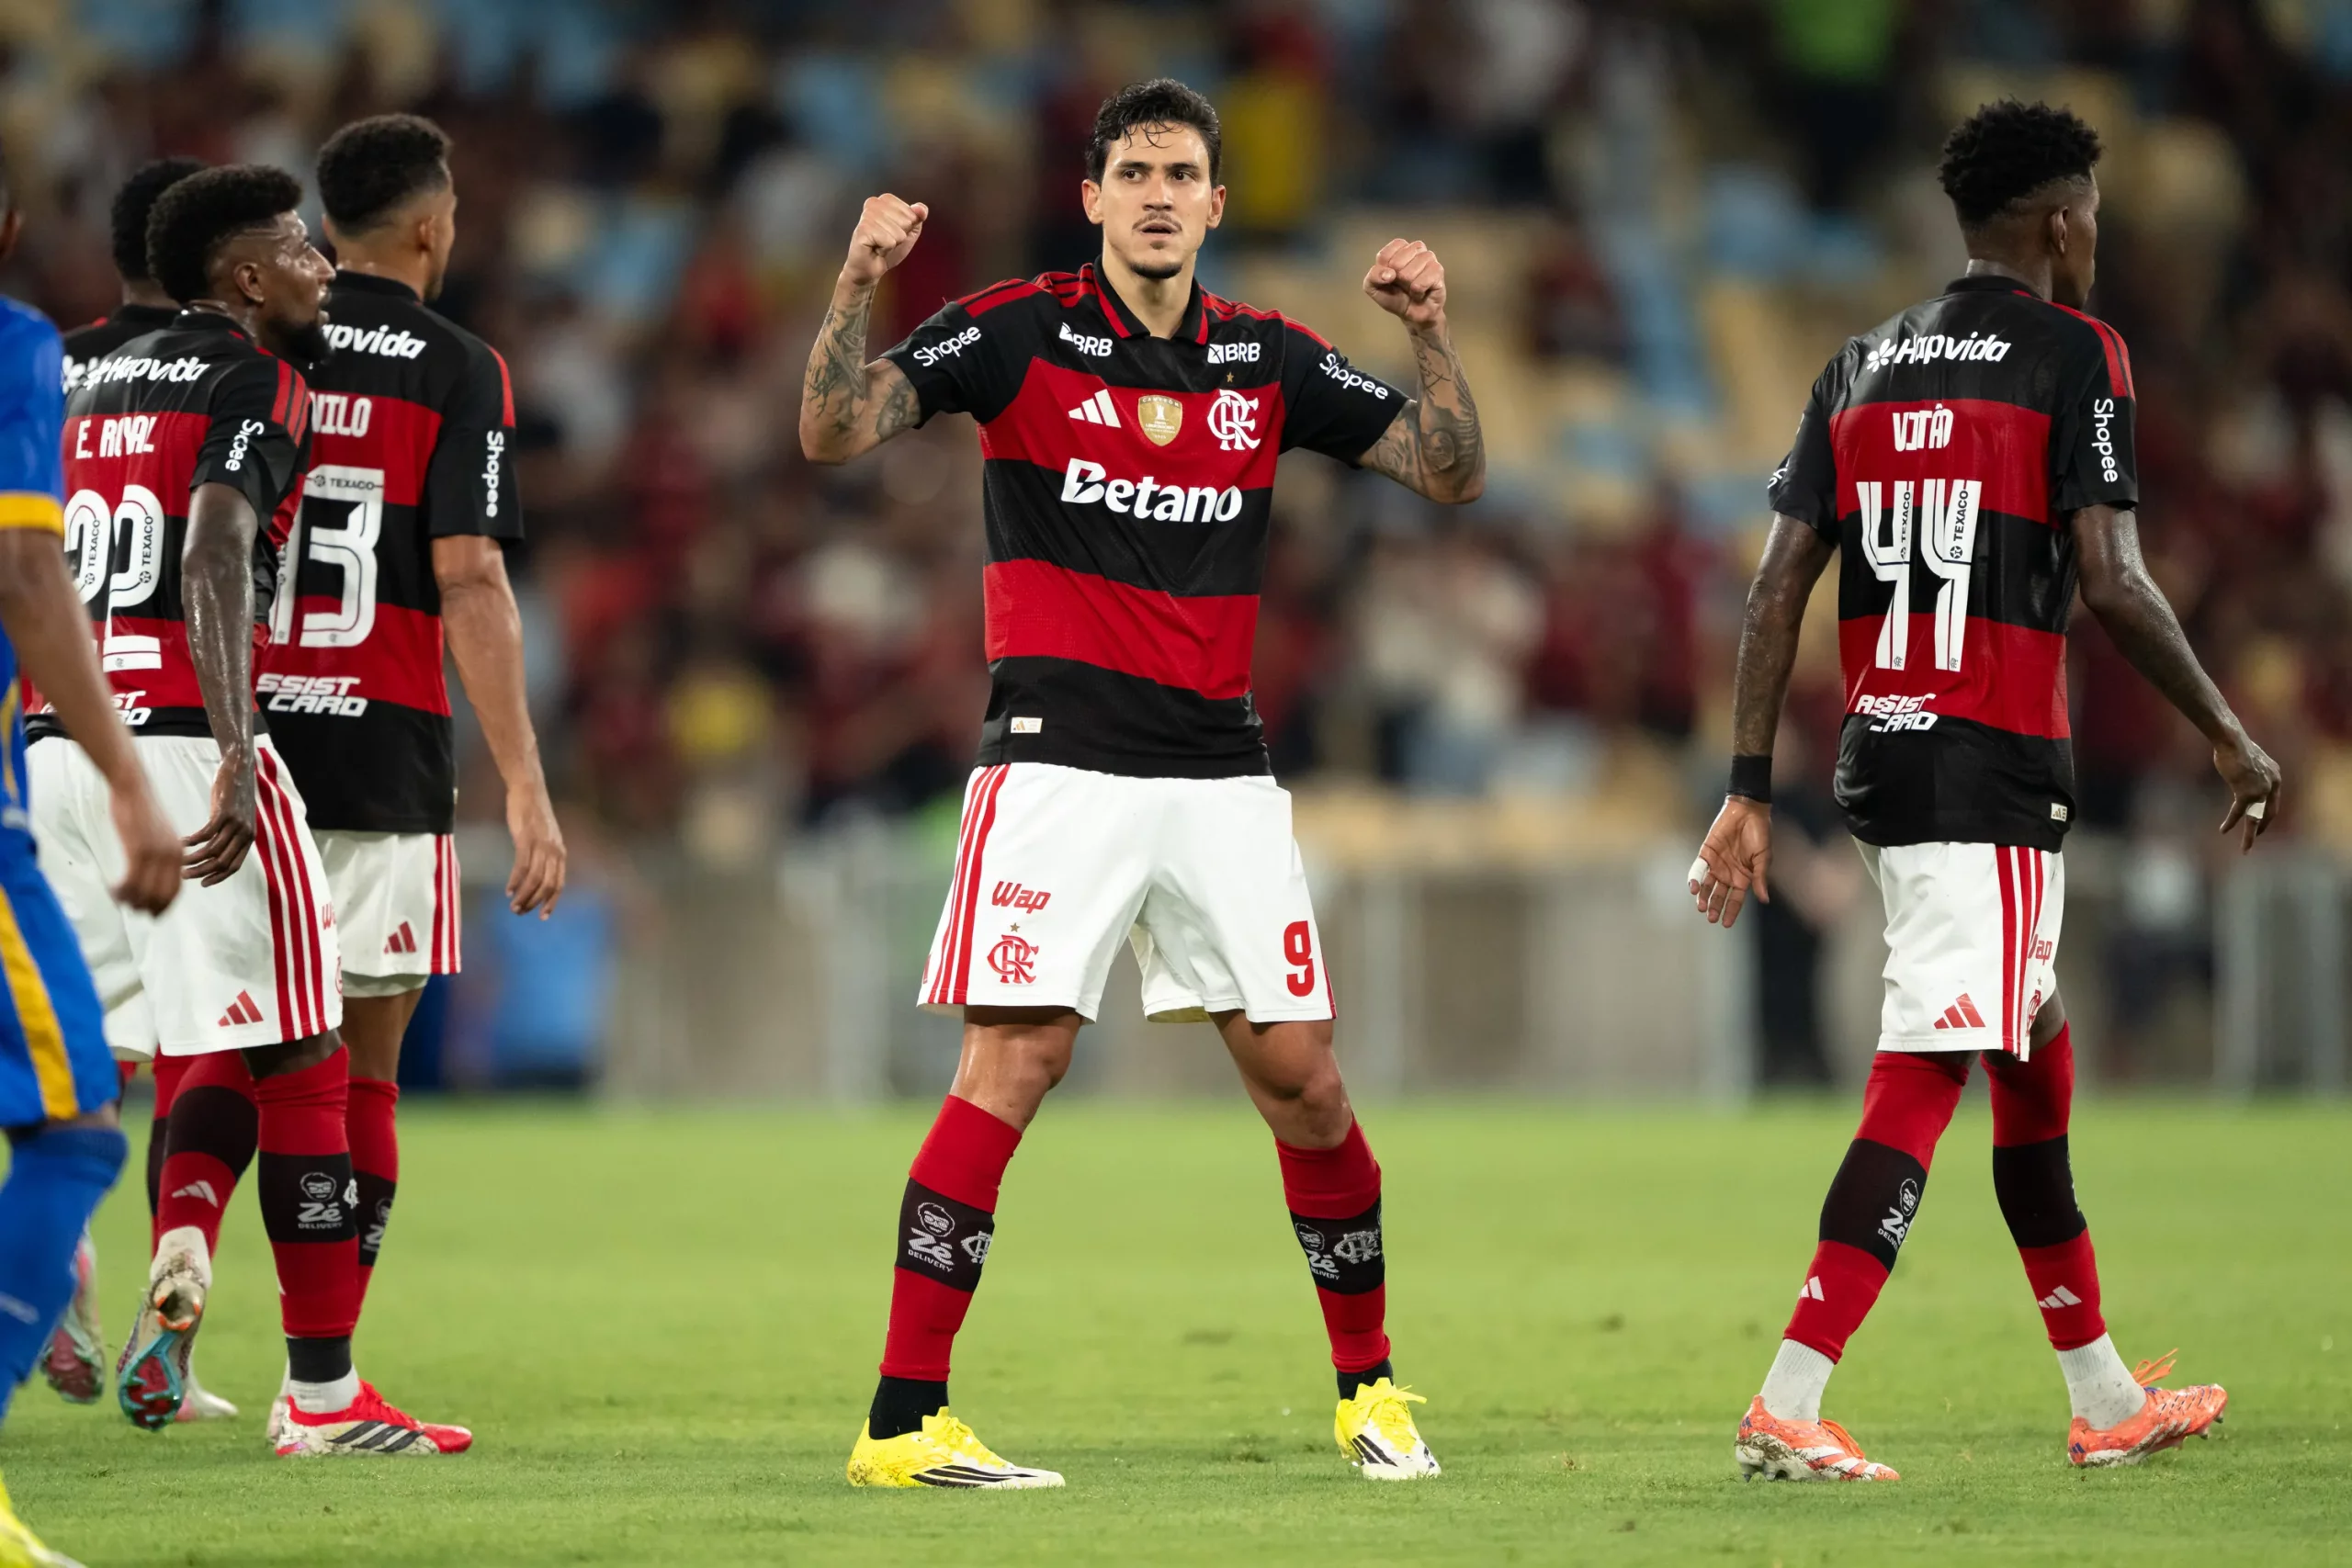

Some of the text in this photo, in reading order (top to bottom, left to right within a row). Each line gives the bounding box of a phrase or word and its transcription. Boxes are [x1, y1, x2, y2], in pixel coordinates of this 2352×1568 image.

[322, 324, 426, 359] pvida
[913, 326, 981, 367] Shopee
[1073, 334, 1113, 357] BRB
[1225, 342, 1261, 362] BRB
[1894, 332, 2011, 364] Hapvida
[1319, 353, 1388, 400] Shopee
[309, 391, 372, 437] NILO
[75, 420, 93, 459] E.
[2091, 399, 2119, 482] Shopee
[330, 478, 375, 491] TEXACO
[481, 430, 504, 517] Shopee
[1061, 457, 1242, 523] Betano
[1901, 491, 1911, 543] TEXACO
[1953, 490, 1969, 542] TEXACO
[87, 519, 101, 568] TEXACO
[141, 515, 154, 567] TEXACO
[1856, 479, 1982, 672] 44
[256, 672, 361, 695] SSIST
[267, 694, 368, 717] CARD
[991, 881, 1051, 914] Wap
[1283, 920, 1315, 997] 9
[297, 1201, 343, 1223] Zé
[908, 1227, 955, 1266] Zé
[908, 1248, 953, 1272] DELIVERY
[1305, 1248, 1340, 1273] Zé
